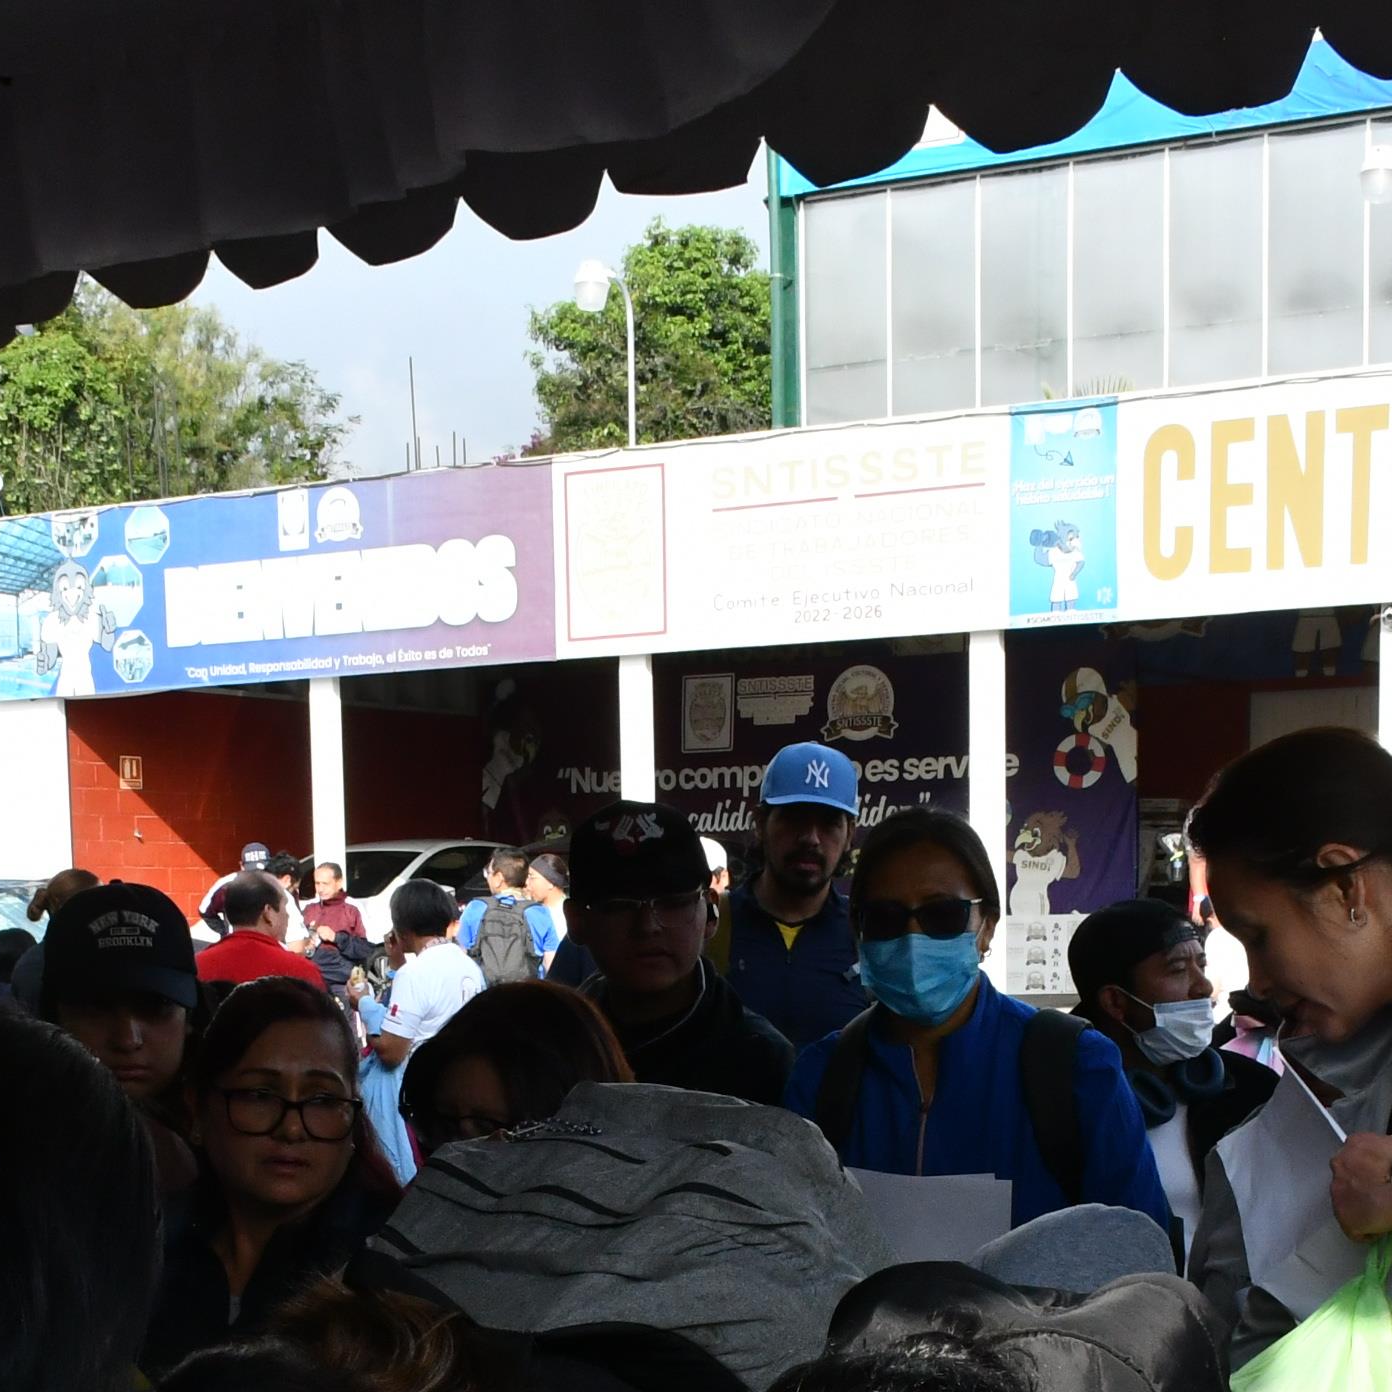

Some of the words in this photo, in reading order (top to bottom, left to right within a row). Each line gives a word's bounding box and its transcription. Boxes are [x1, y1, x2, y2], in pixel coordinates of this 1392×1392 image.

[711, 440, 987, 501] SNTISSSTE
[791, 586, 881, 608] Ejecutivo
[889, 575, 975, 598] Nacional
[793, 604, 884, 624] 2022-2026
[210, 661, 248, 677] Unidad,
[249, 656, 333, 679] Responsabilidad
[333, 657, 341, 671] y
[342, 650, 385, 669] Trabajo,
[386, 651, 397, 664] el
[398, 647, 423, 663] Éxito
[424, 650, 437, 660] es
[438, 647, 453, 659] de
[738, 675, 814, 694] SNTISSSTE
[835, 715, 884, 731] SNTISSSTE
[804, 759, 831, 789] NY
[864, 757, 901, 783] es
[88, 910, 119, 936] NEW
[119, 908, 160, 935] YORK
[97, 935, 153, 949] BROOKLYN
